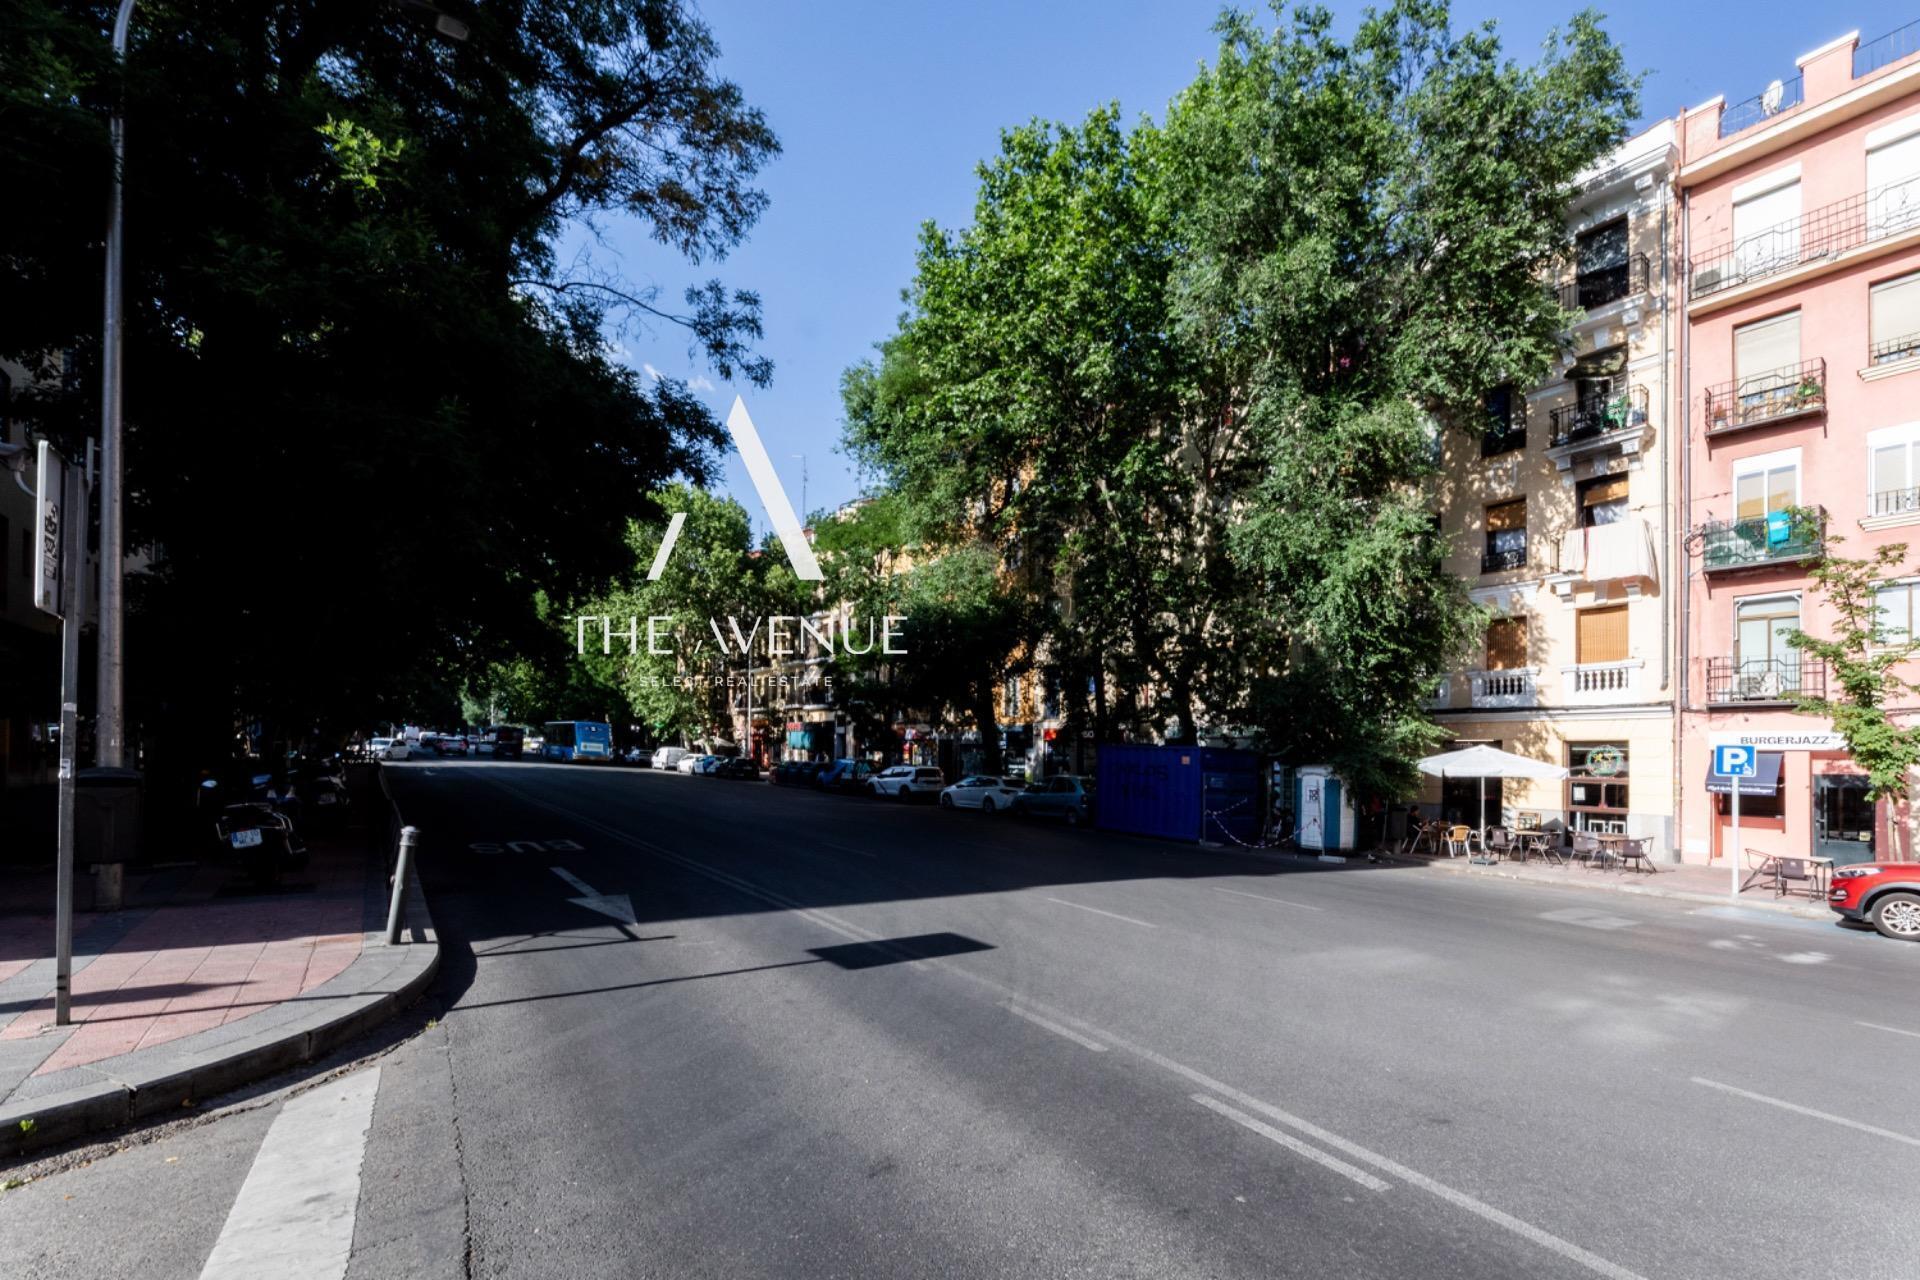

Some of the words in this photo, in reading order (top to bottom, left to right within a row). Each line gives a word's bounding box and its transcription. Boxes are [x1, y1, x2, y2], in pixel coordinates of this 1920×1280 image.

[1740, 735, 1829, 745] BURGERJAZZ
[1723, 747, 1748, 773] P
[467, 839, 586, 855] BUS
